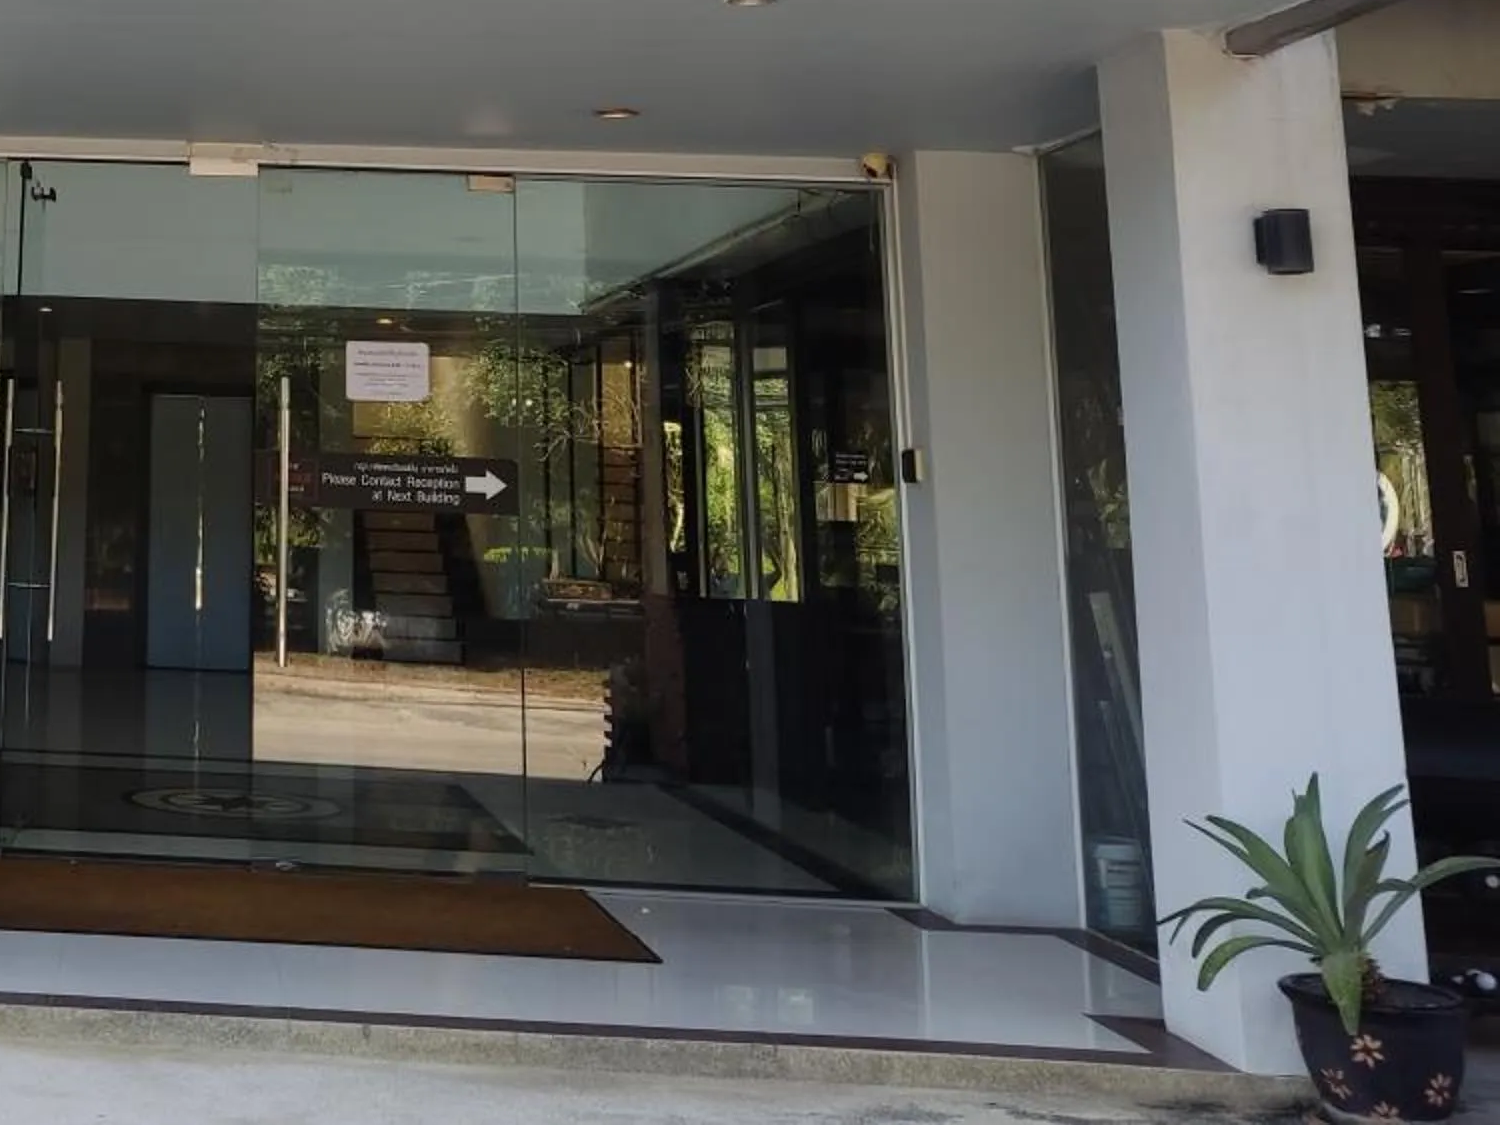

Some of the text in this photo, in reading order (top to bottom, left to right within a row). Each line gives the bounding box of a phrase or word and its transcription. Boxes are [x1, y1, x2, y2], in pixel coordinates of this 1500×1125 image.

[321, 472, 357, 486] Please
[361, 474, 402, 487] Contact
[406, 476, 461, 490] Reception
[387, 489, 413, 503] Next
[417, 490, 461, 506] Building
